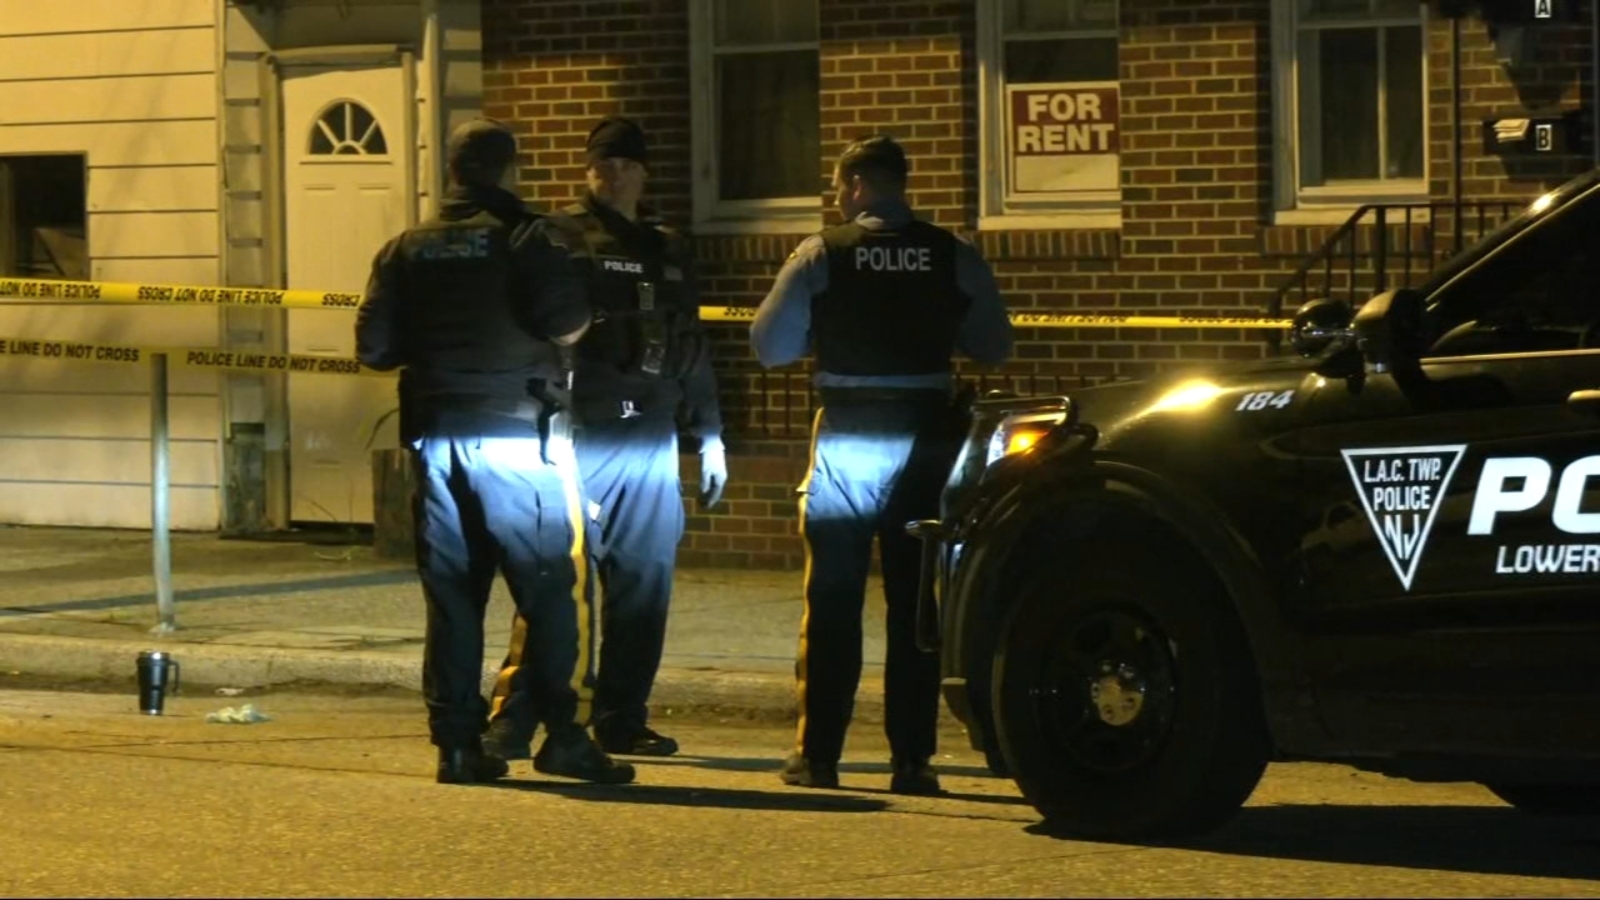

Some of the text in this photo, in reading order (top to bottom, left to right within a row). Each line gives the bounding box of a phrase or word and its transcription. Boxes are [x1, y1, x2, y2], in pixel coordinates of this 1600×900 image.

[1537, 0, 1550, 16] A
[1028, 93, 1101, 121] FOR
[1018, 123, 1115, 152] RENT
[1537, 127, 1550, 149] B
[408, 227, 489, 261] OLCE
[604, 260, 643, 274] POLICE
[855, 246, 932, 271] POLICE
[24, 282, 37, 297] DO
[39, 283, 62, 298] LINE
[65, 284, 100, 299] POLICE
[138, 286, 284, 304] POLICE LINE DO NOT CROSS
[321, 293, 361, 306] CROSS
[10, 341, 39, 356] LINE
[44, 343, 61, 358] DO
[65, 345, 95, 359] NOT
[95, 347, 139, 362] CROSS
[187, 352, 361, 374] POLICE LINE DO NOT CROSS
[1235, 390, 1295, 411] 184
[1364, 459, 1405, 482] L.A.C.
[1373, 486, 1431, 511] POLICE
[1384, 514, 1420, 560] NJ
[1496, 545, 1600, 573] LOWER
